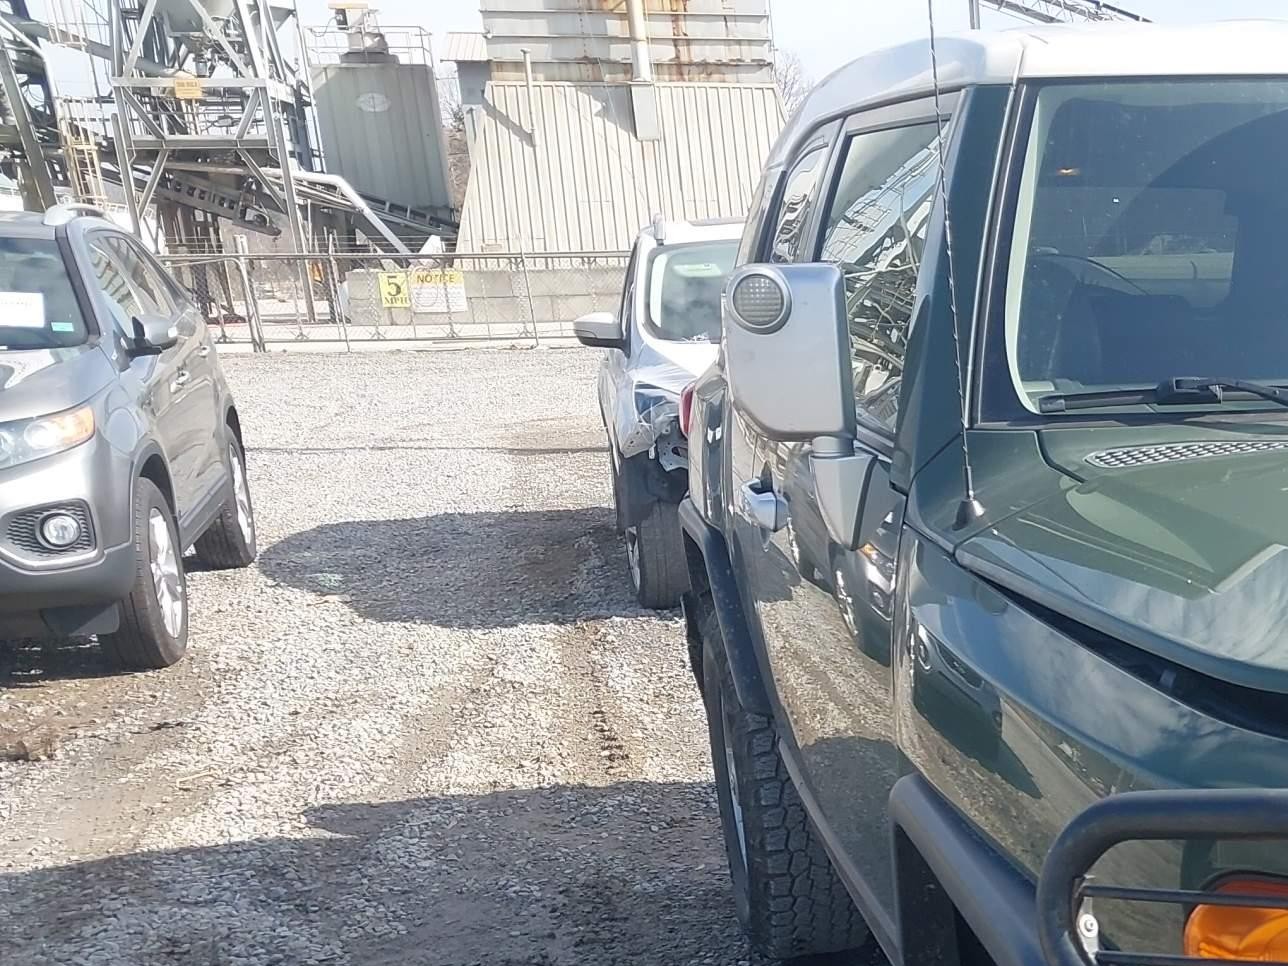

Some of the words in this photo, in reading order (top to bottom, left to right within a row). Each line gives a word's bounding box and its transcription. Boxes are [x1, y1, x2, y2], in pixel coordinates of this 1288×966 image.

[416, 273, 455, 284] NOTICE
[387, 275, 402, 297] 5
[384, 296, 408, 305] MPH
